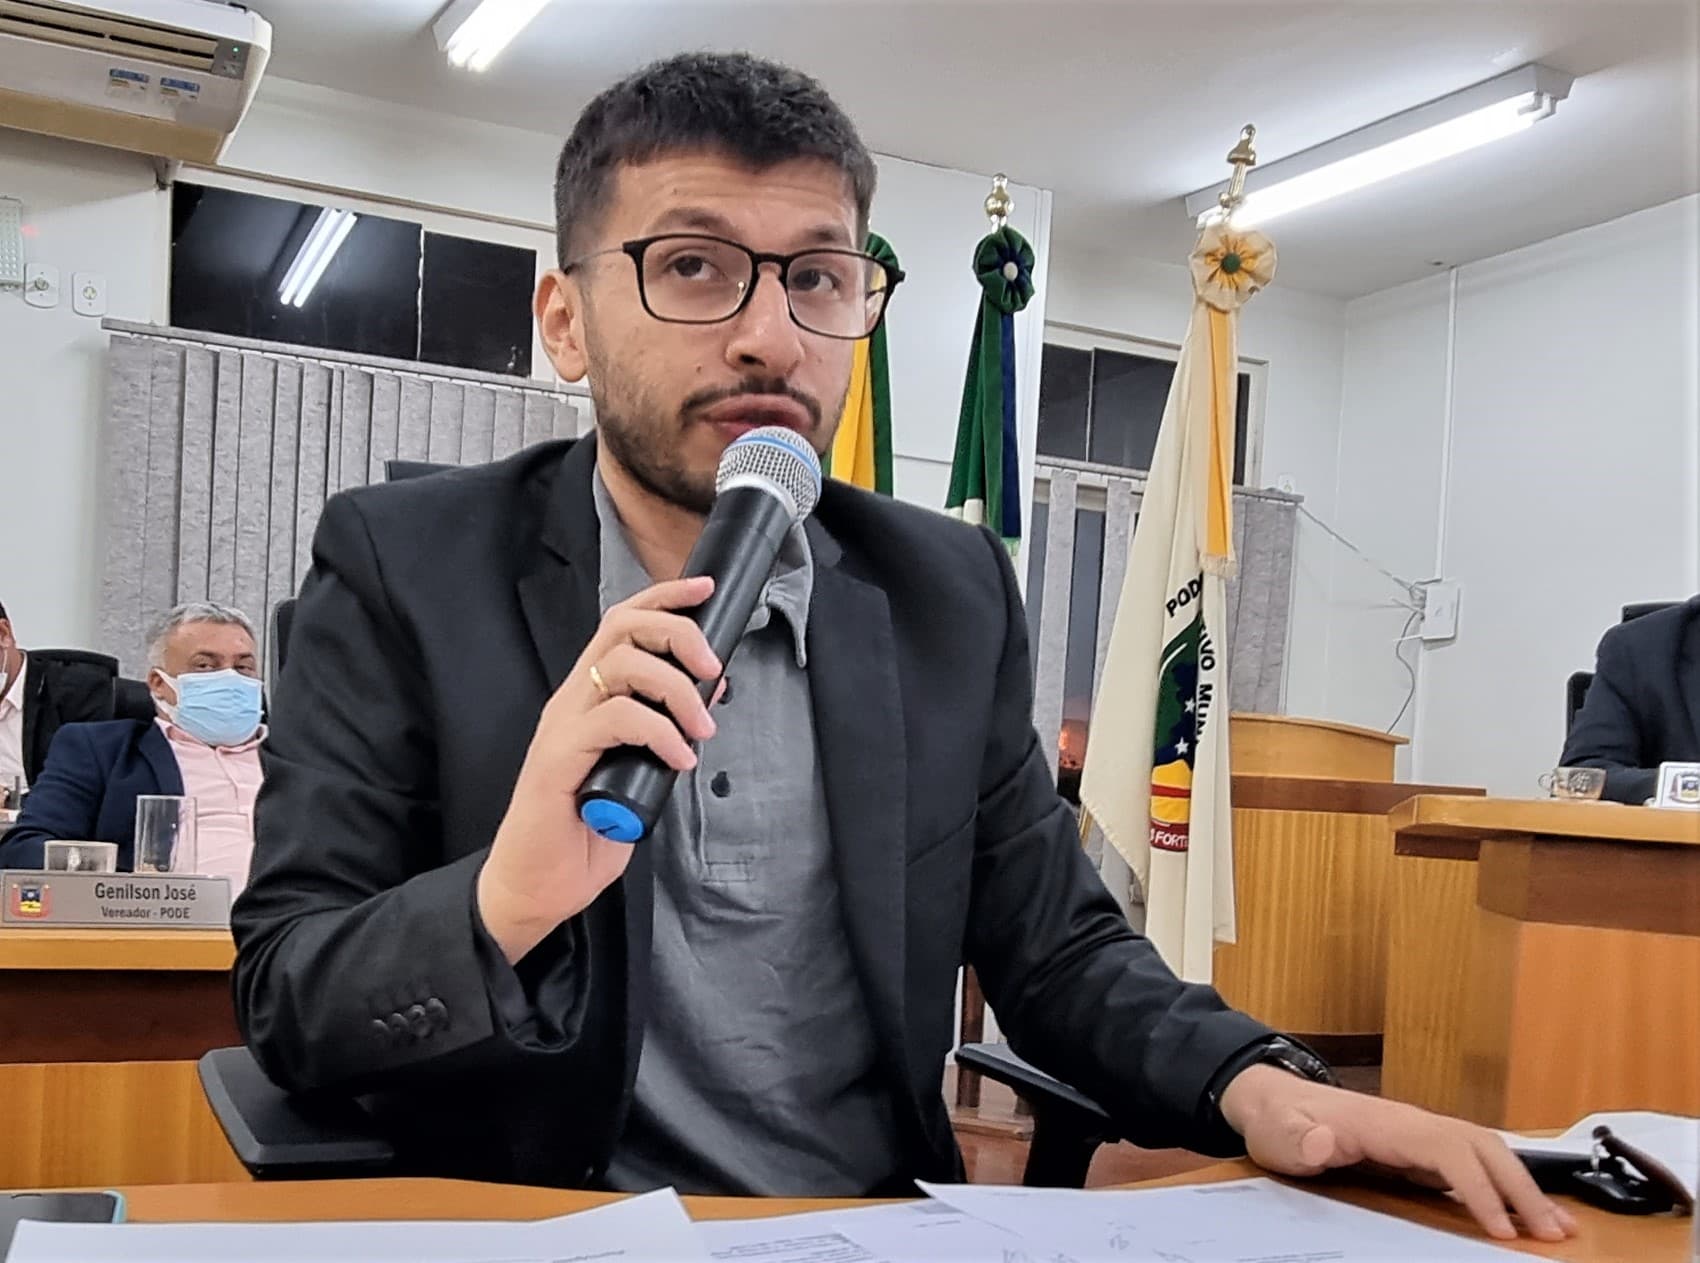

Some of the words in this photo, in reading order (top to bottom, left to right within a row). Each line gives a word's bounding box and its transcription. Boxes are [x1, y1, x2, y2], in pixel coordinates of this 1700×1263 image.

[95, 882, 161, 900] Genilson
[164, 884, 197, 901] José
[101, 906, 150, 918] Vereador
[160, 907, 190, 919] PODE
